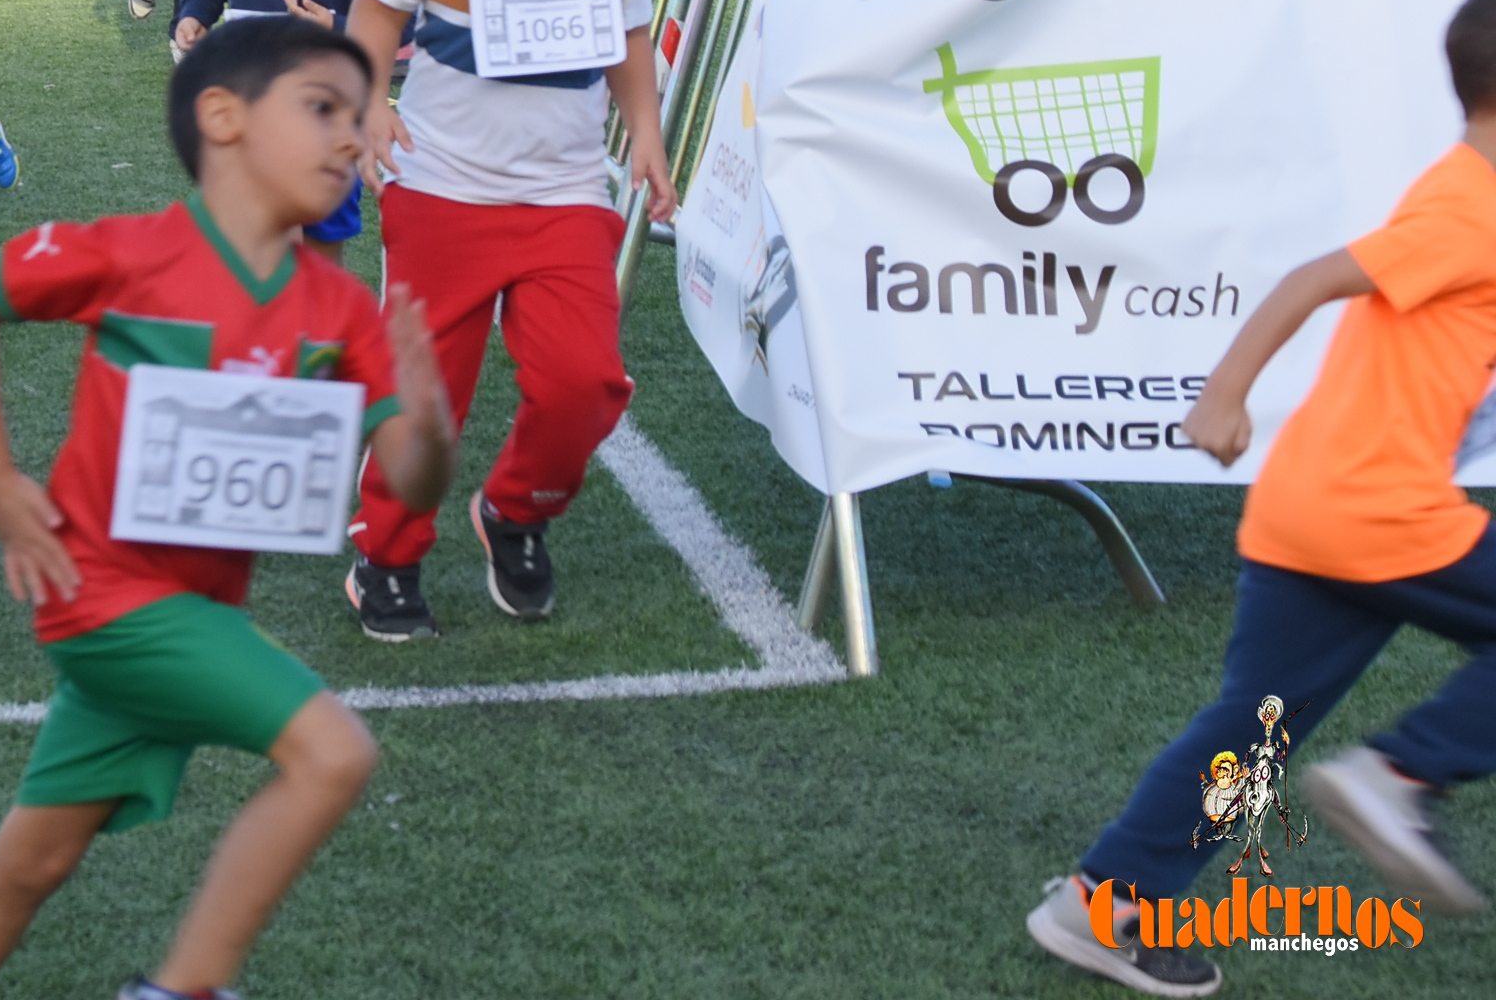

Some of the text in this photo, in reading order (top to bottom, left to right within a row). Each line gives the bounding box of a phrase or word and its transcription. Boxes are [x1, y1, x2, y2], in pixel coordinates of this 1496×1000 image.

[517, 15, 585, 43] 1066
[864, 245, 1240, 336] family cash
[898, 371, 1206, 402] TALLERES
[187, 454, 295, 510] 960
